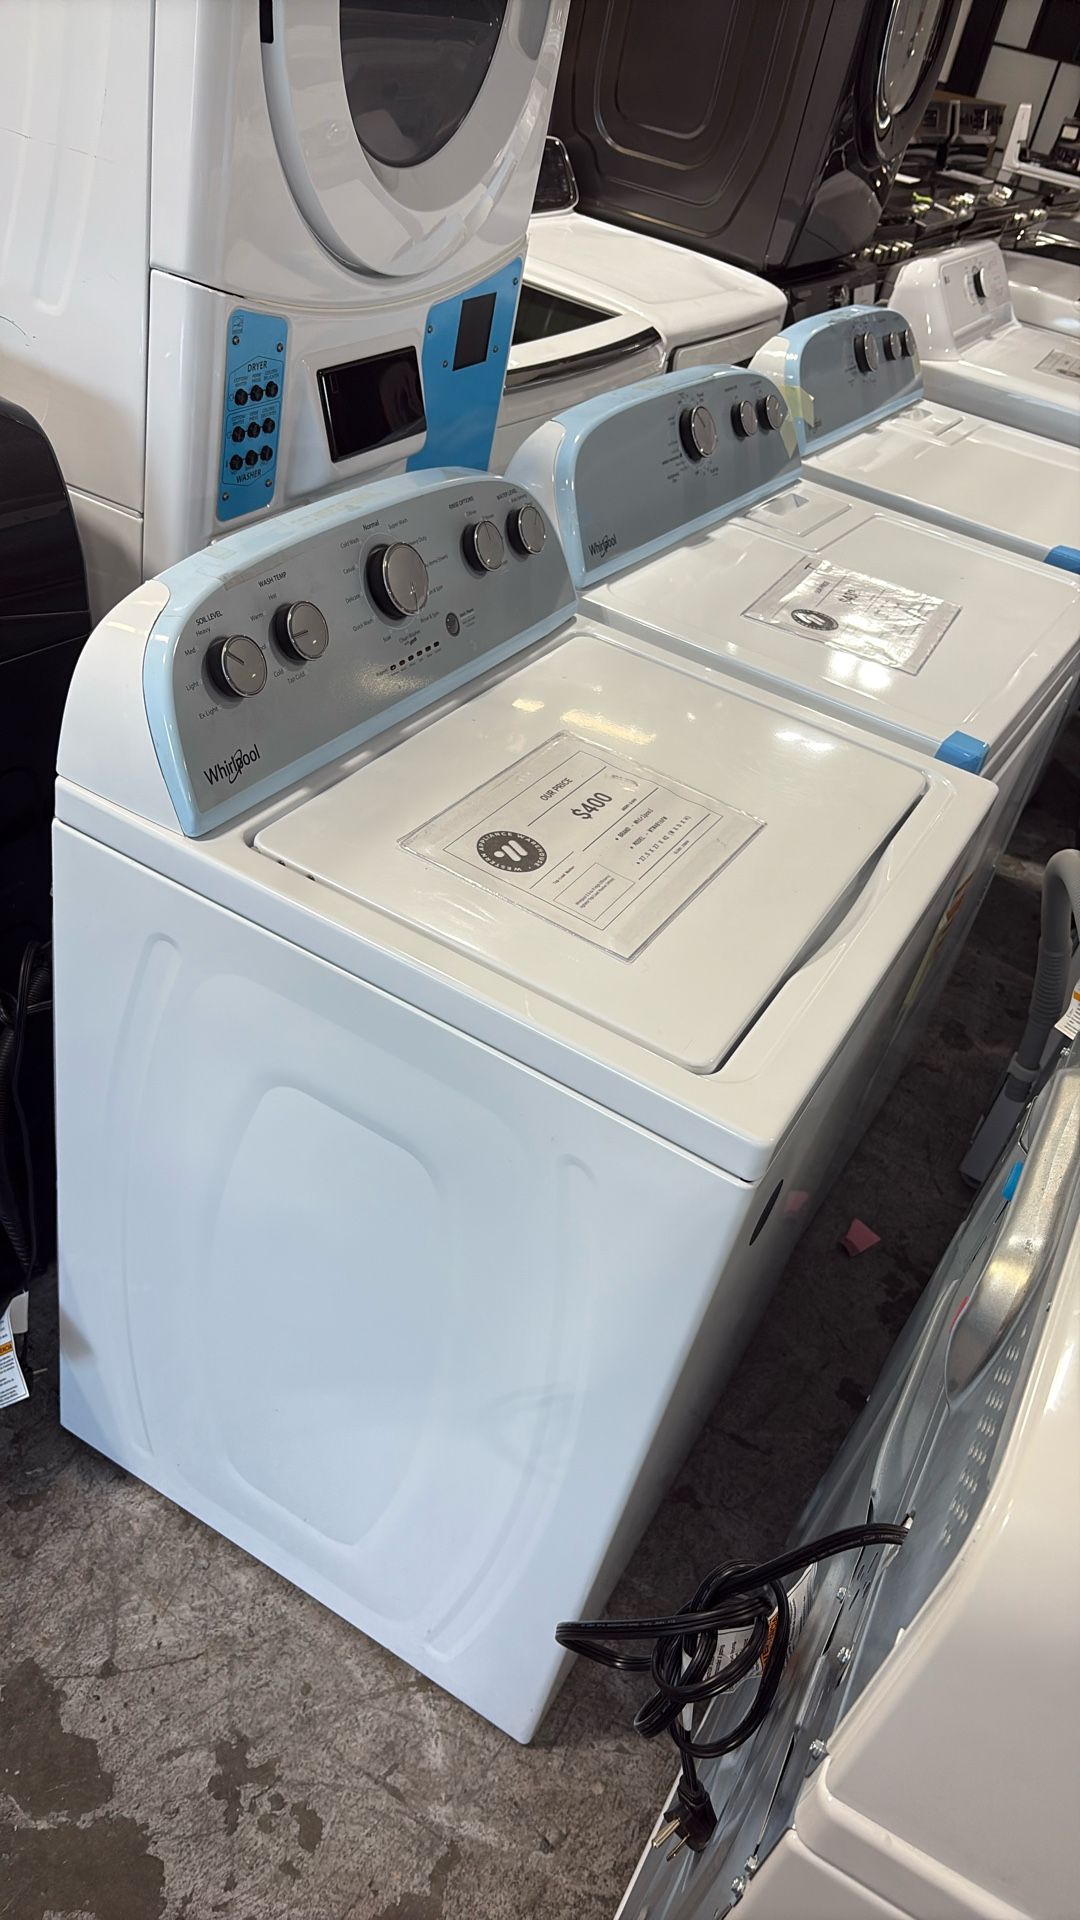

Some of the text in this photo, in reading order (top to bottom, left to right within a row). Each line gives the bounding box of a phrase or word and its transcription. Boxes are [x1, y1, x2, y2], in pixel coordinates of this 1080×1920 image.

[247, 360, 268, 373] DRYER
[236, 469, 262, 484] WASHER
[362, 519, 380, 531] Normal
[587, 534, 617, 558] Whirlpool
[257, 571, 287, 588] WASH TEMP
[268, 592, 278, 601] Hot
[195, 610, 223, 626] SOIL LEVEL
[249, 611, 264, 622] Warm
[195, 627, 211, 638] Heavy
[184, 646, 197, 657] Med
[273, 668, 285, 678] Cold
[185, 680, 200, 692] Light
[198, 705, 219, 720] Ex Light
[203, 743, 261, 786] Whirlpool
[539, 777, 574, 802] OUR PRICE
[570, 791, 613, 821] $400
[617, 826, 632, 838] BRAND
[633, 807, 654, 825] Whirlpool
[478, 831, 546, 872] WESTERN APPLIANCE WAREHOUSE
